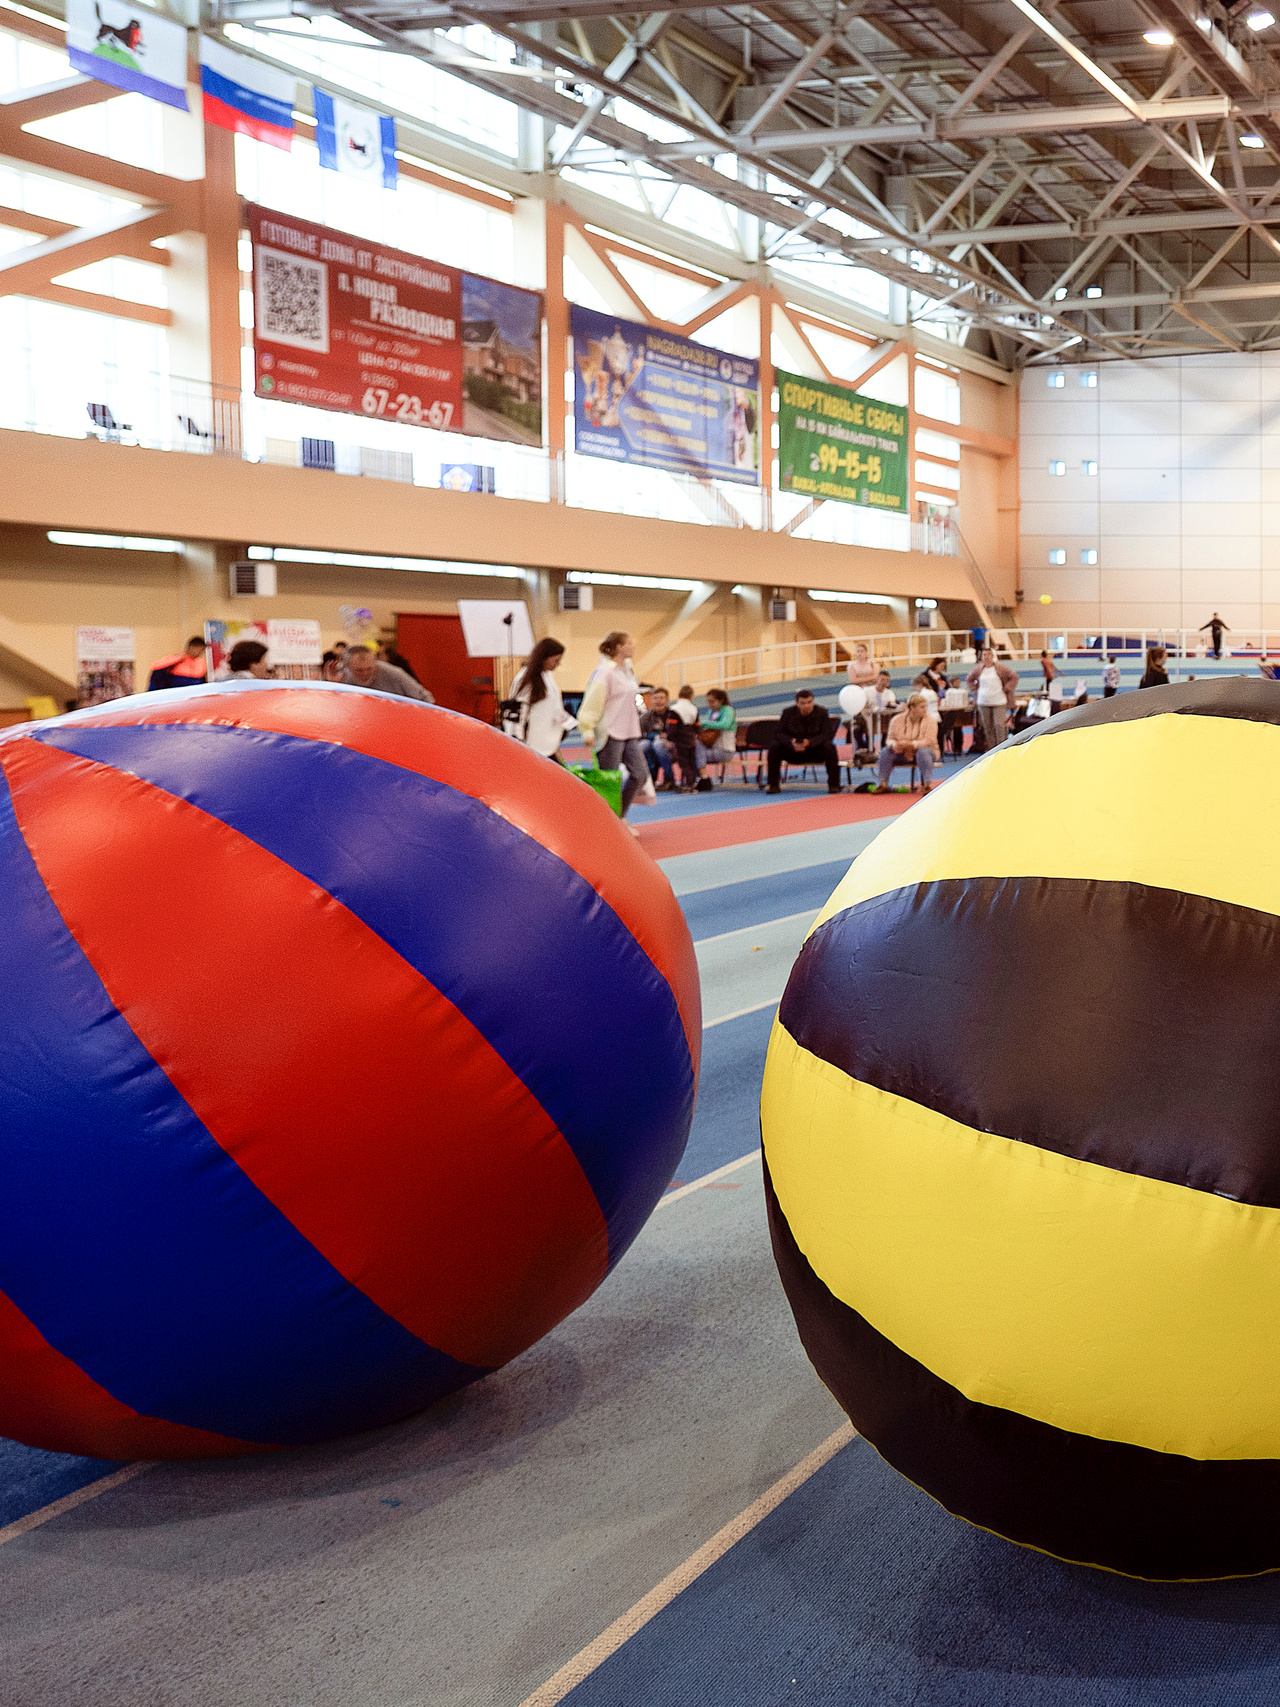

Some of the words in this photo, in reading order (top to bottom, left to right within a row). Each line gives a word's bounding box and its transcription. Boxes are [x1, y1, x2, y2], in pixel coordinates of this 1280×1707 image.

[320, 238, 355, 265] ДОМА
[356, 250, 373, 271] ОТ
[353, 275, 397, 304] НОВАЯ
[370, 299, 455, 340] РАЗВОДНАЯ
[362, 387, 454, 429] 67-23-67
[783, 382, 865, 425] СПОРТИВНЫЕ
[866, 407, 904, 436] СБОРЫ
[819, 443, 882, 484] 99-15-15
